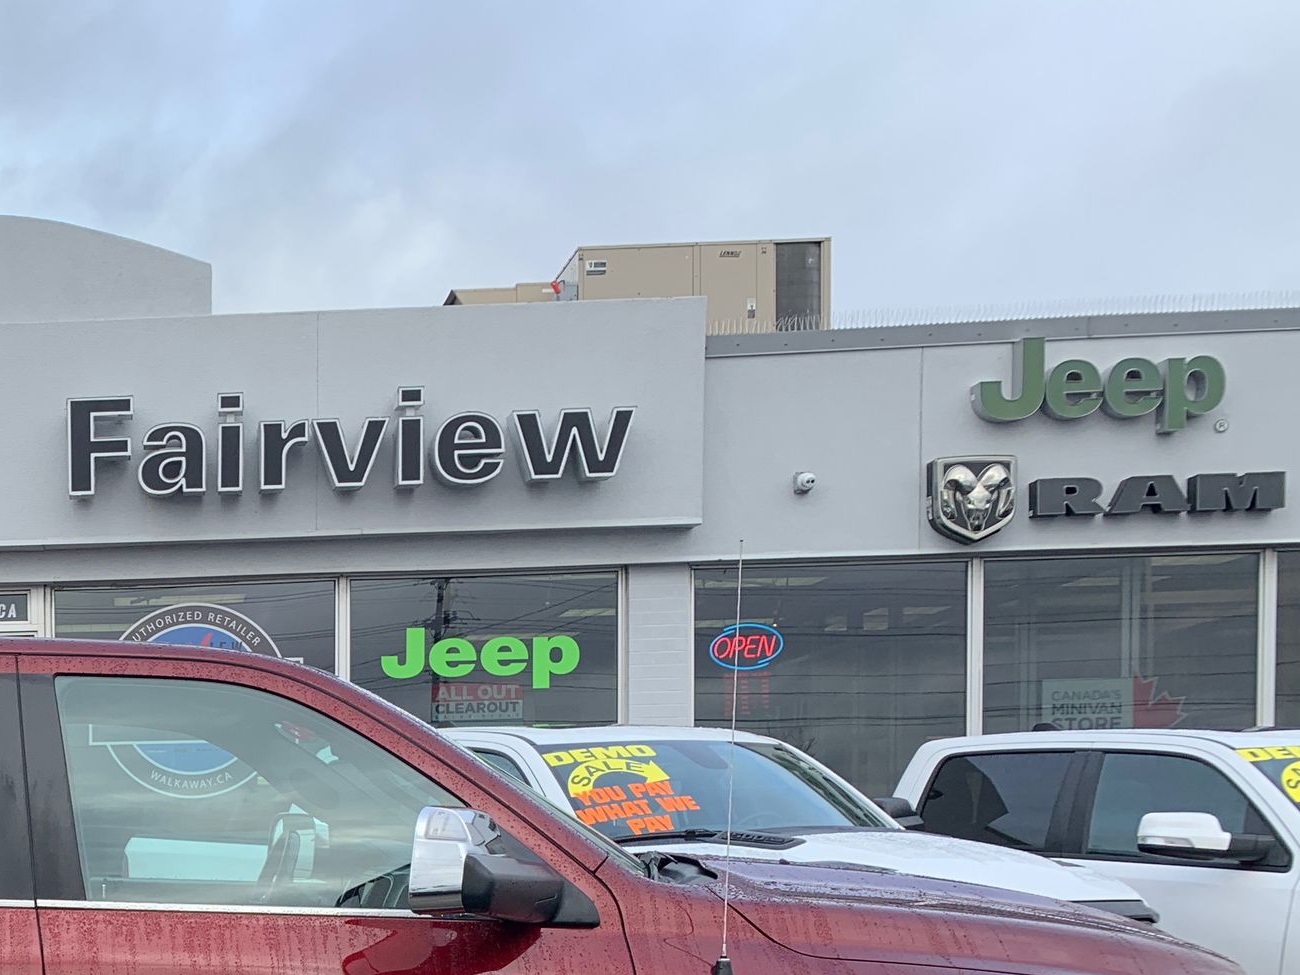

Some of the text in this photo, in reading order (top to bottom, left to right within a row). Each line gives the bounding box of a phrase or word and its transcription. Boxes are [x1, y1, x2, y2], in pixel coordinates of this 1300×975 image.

[971, 337, 1226, 434] Jeep
[66, 386, 638, 498] Fairview
[1029, 471, 1286, 518] RAM
[132, 611, 261, 647] UTHORIZED RETAILER
[381, 628, 580, 688] Jeep
[713, 634, 777, 659] OPEN
[436, 684, 520, 700] ALL OUT
[1052, 690, 1122, 701] CANADA'S
[435, 702, 519, 714] CLEAROUT
[1051, 702, 1122, 716] MINIVAN
[542, 744, 657, 767] DEMO
[150, 767, 233, 790] WALKAWAY.CA
[571, 761, 646, 787] SALE
[573, 780, 675, 806] YOU PAY
[575, 795, 701, 826] WHAT WE
[627, 814, 675, 836] PAY
